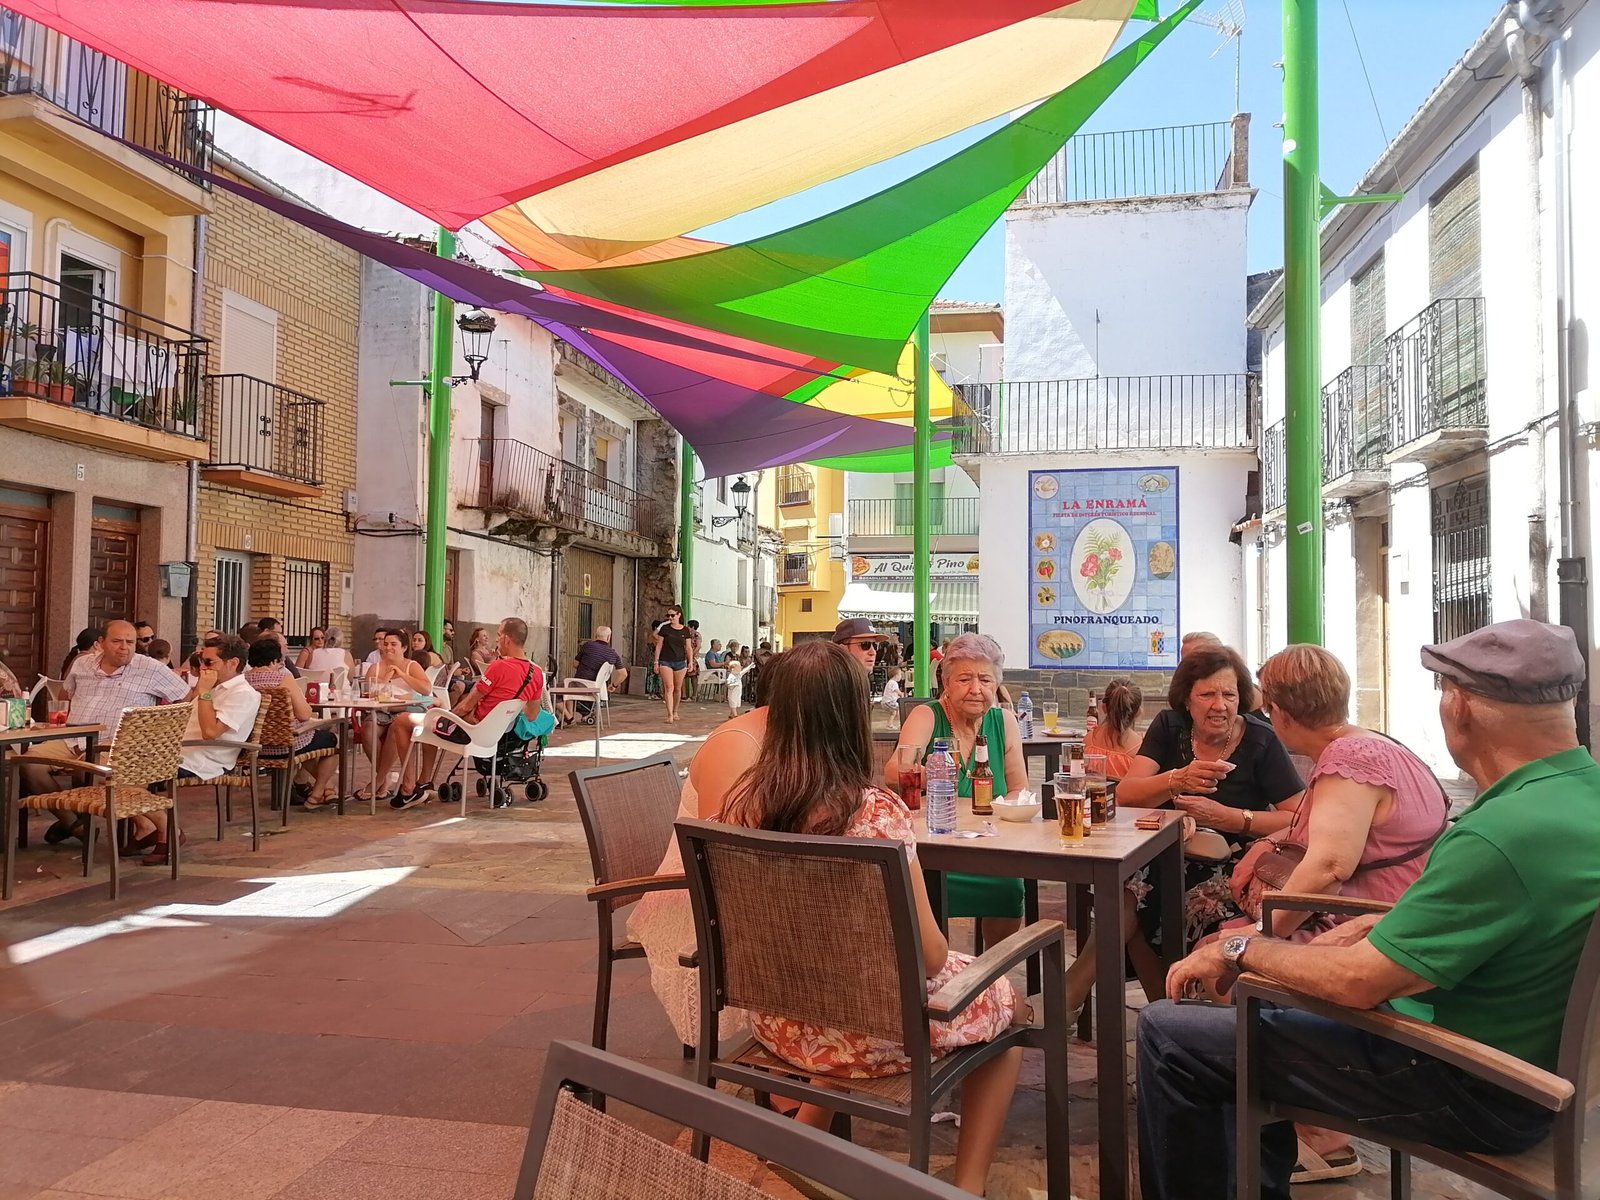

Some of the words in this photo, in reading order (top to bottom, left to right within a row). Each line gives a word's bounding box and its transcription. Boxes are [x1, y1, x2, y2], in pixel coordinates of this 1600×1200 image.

[77, 465, 84, 479] 5
[1062, 500, 1081, 510] LA
[1085, 494, 1148, 509] ENRAMÁ
[873, 562, 888, 574] Al
[936, 558, 965, 569] Pino
[1053, 615, 1160, 626] PINOFRANQUEADO
